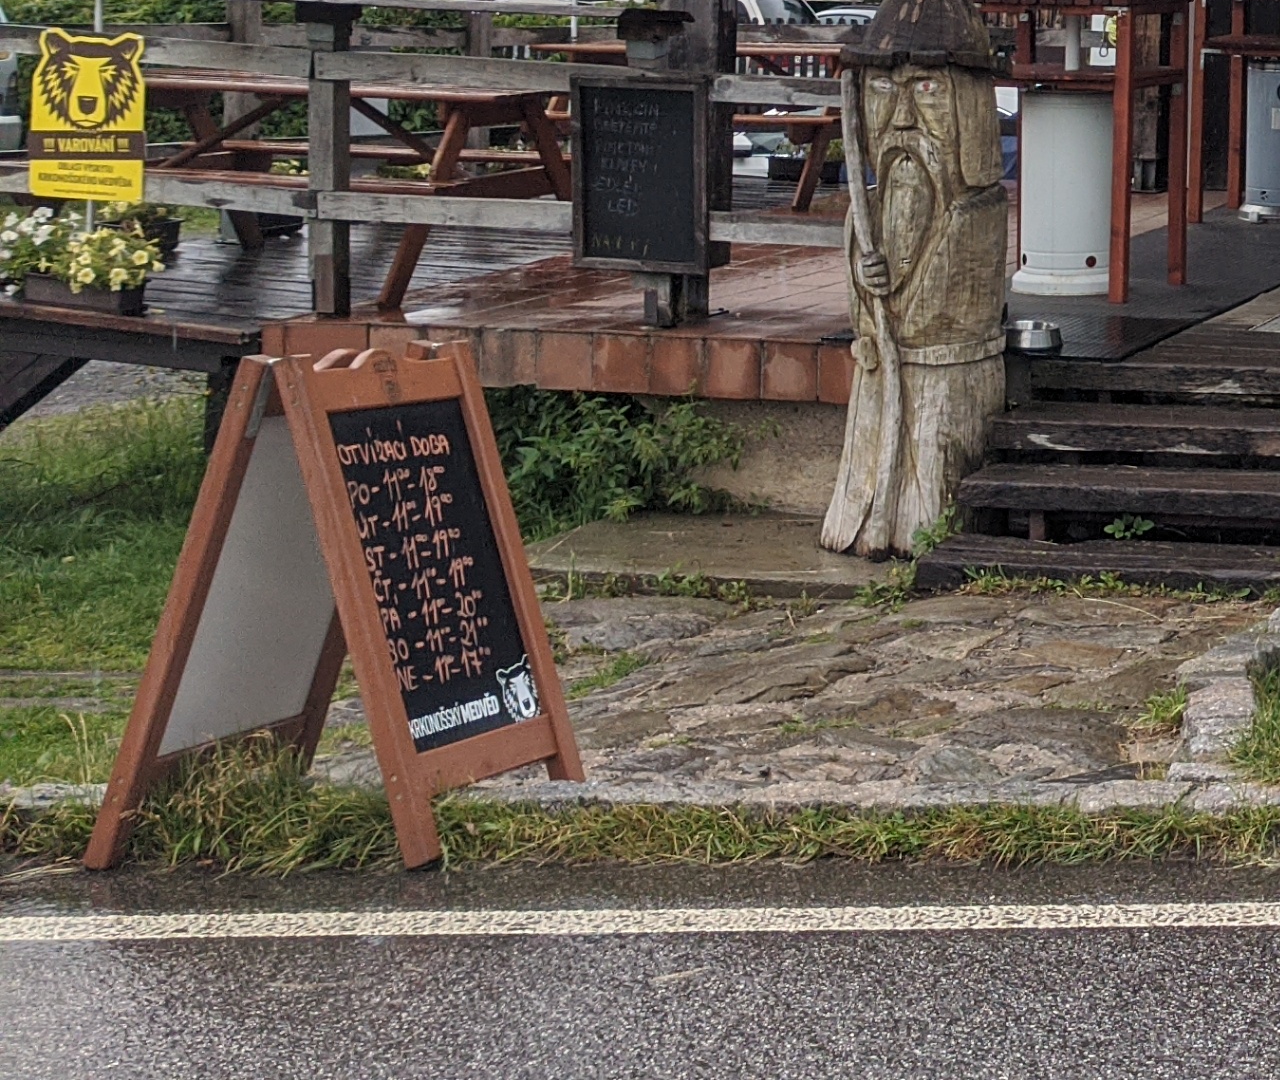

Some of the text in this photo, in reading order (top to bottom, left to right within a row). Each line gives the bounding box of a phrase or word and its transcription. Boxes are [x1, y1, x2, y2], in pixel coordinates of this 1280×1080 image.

[57, 134, 116, 153] VAROVÁNÍ
[410, 434, 451, 457] DOBA
[365, 545, 385, 572] ST
[396, 665, 420, 692] NE
[460, 691, 500, 725] MEDVĚD
